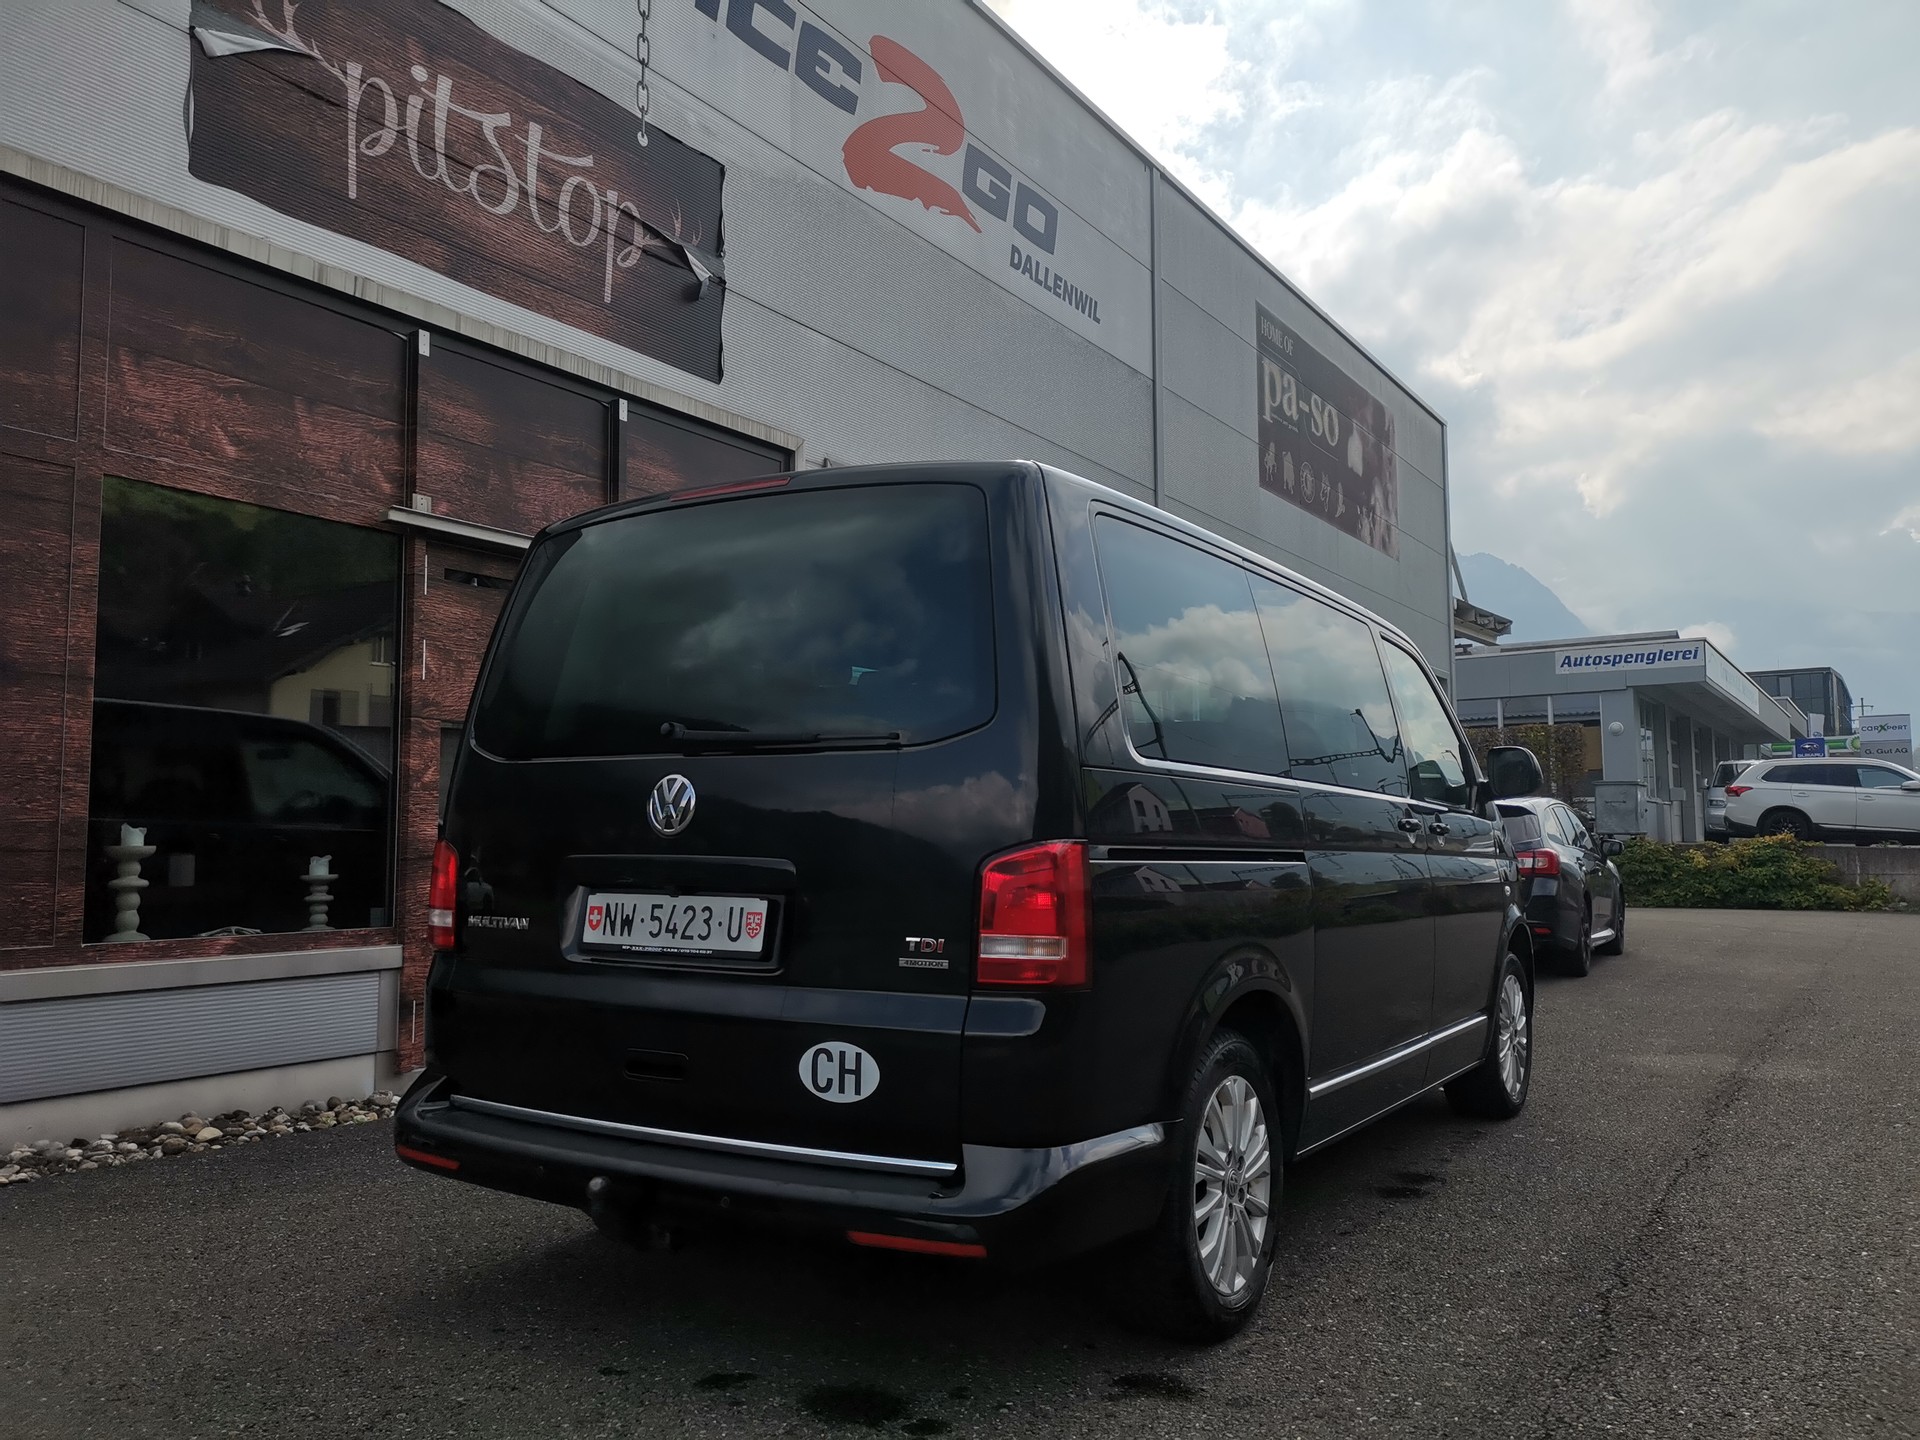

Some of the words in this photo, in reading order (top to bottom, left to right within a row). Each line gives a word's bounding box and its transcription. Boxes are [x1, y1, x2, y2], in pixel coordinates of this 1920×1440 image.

[694, 0, 862, 116] CE
[344, 60, 645, 303] pitstop
[1010, 243, 1102, 325] DALLENWIL
[1261, 316, 1284, 348] HOME
[1284, 337, 1294, 356] OF
[1262, 359, 1340, 447] pa-so
[1560, 646, 1700, 668] Autospenglerei
[905, 936, 945, 953] TDI
[810, 1047, 863, 1097] CH
